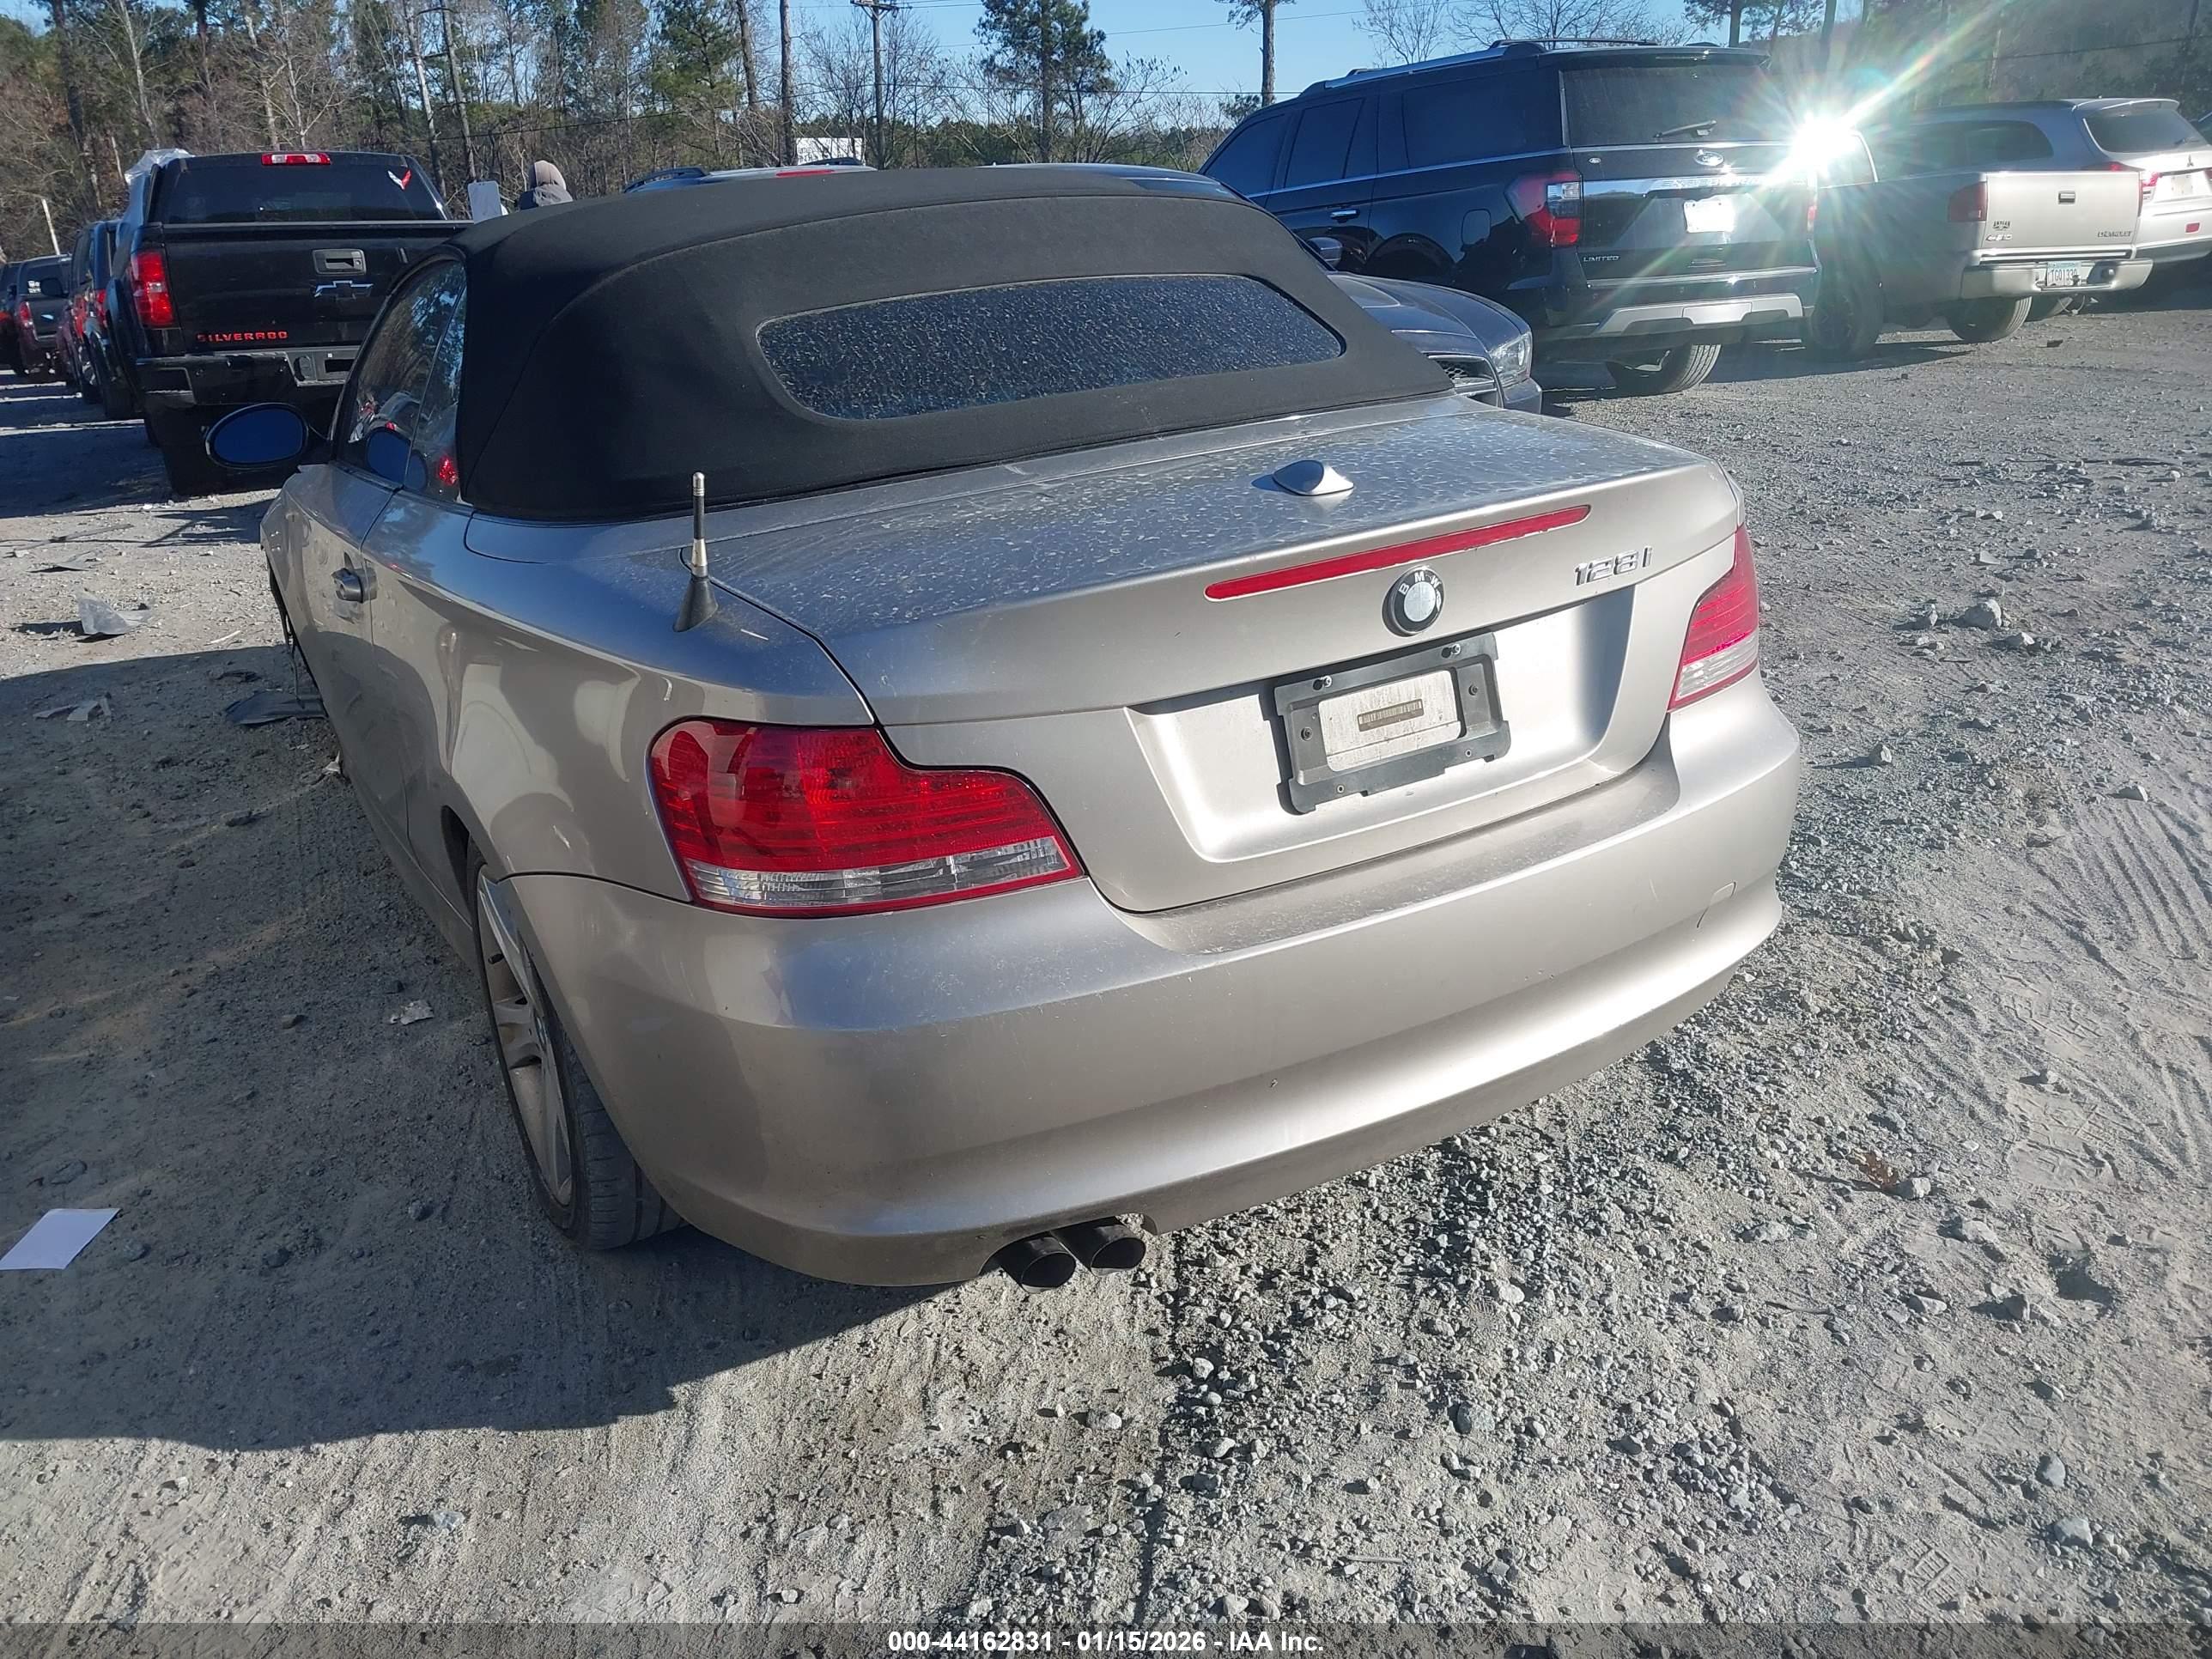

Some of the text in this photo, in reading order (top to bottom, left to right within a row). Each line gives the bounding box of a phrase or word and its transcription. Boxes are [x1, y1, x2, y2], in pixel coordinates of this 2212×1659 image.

[197, 331, 288, 342] SILVERADO
[1574, 545, 1652, 586] 128i
[1399, 571, 1442, 595] BMW
